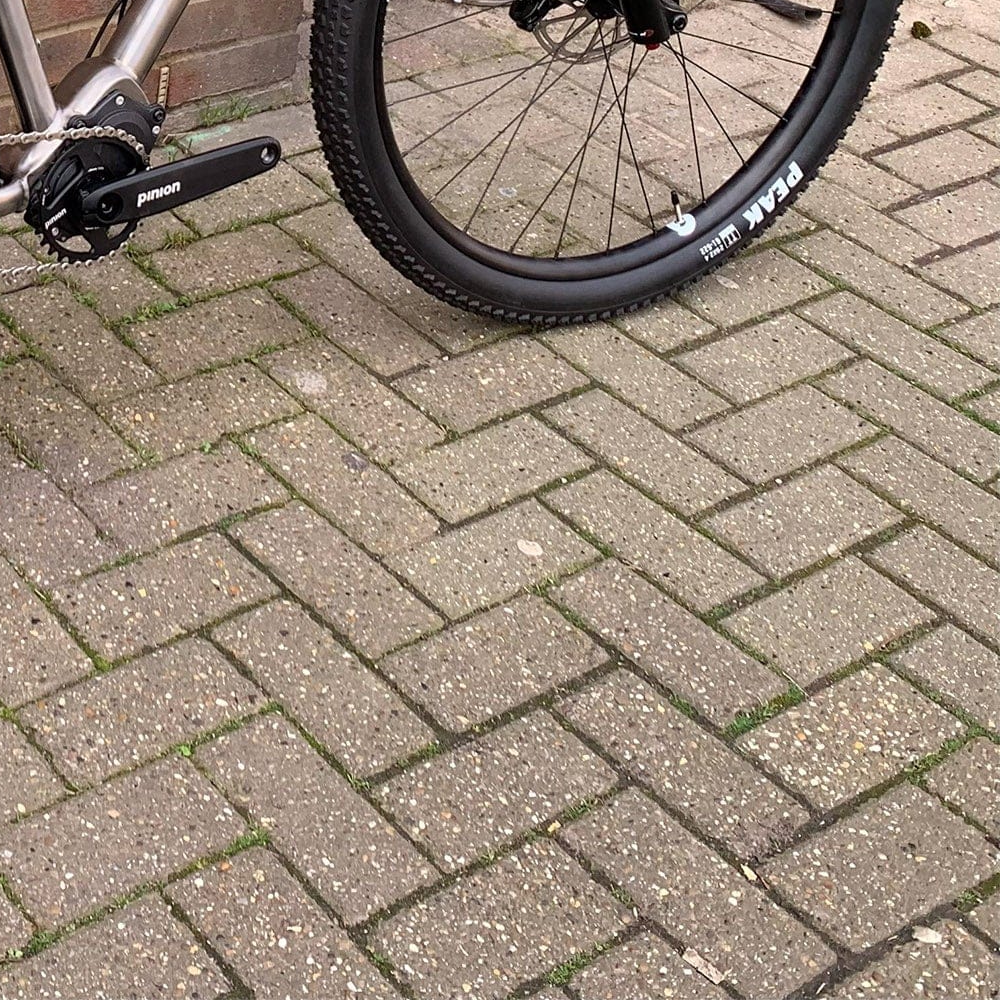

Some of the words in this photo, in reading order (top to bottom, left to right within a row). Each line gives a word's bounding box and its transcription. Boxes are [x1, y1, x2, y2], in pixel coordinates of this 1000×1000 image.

[137, 181, 182, 208] pinion
[742, 160, 804, 231] PEAK
[44, 207, 67, 229] pinion
